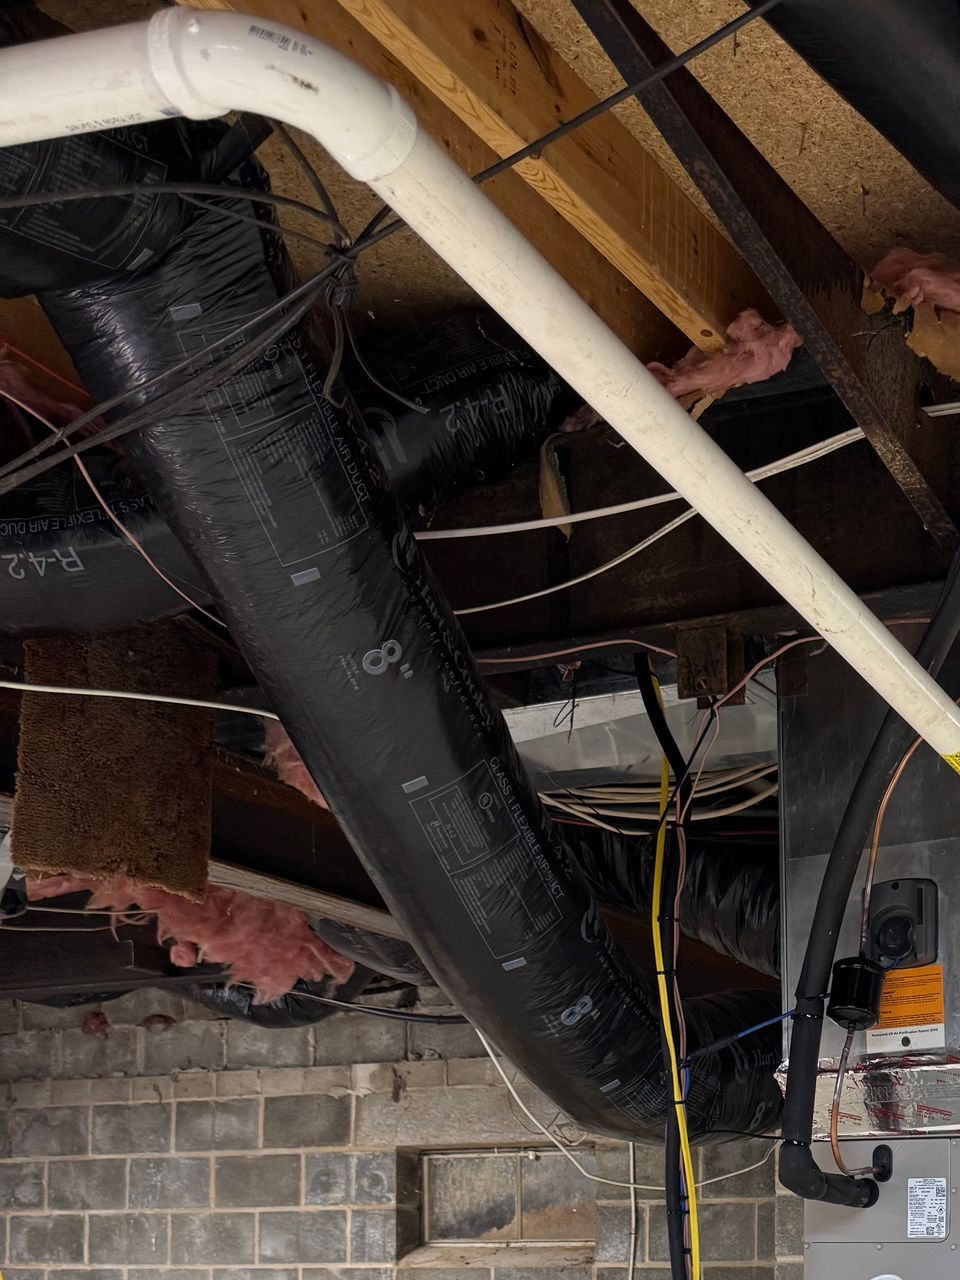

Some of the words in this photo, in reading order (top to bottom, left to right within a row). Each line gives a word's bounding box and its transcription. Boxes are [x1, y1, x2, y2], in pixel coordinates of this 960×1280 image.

[333, 435, 351, 462] AIR
[347, 463, 371, 502] DUCT
[0, 521, 27, 536] DUC
[29, 519, 50, 533] AIR
[0, 546, 86, 580] R-4.2
[489, 756, 513, 796] CLASS
[511, 803, 541, 850] FLEXIBLE
